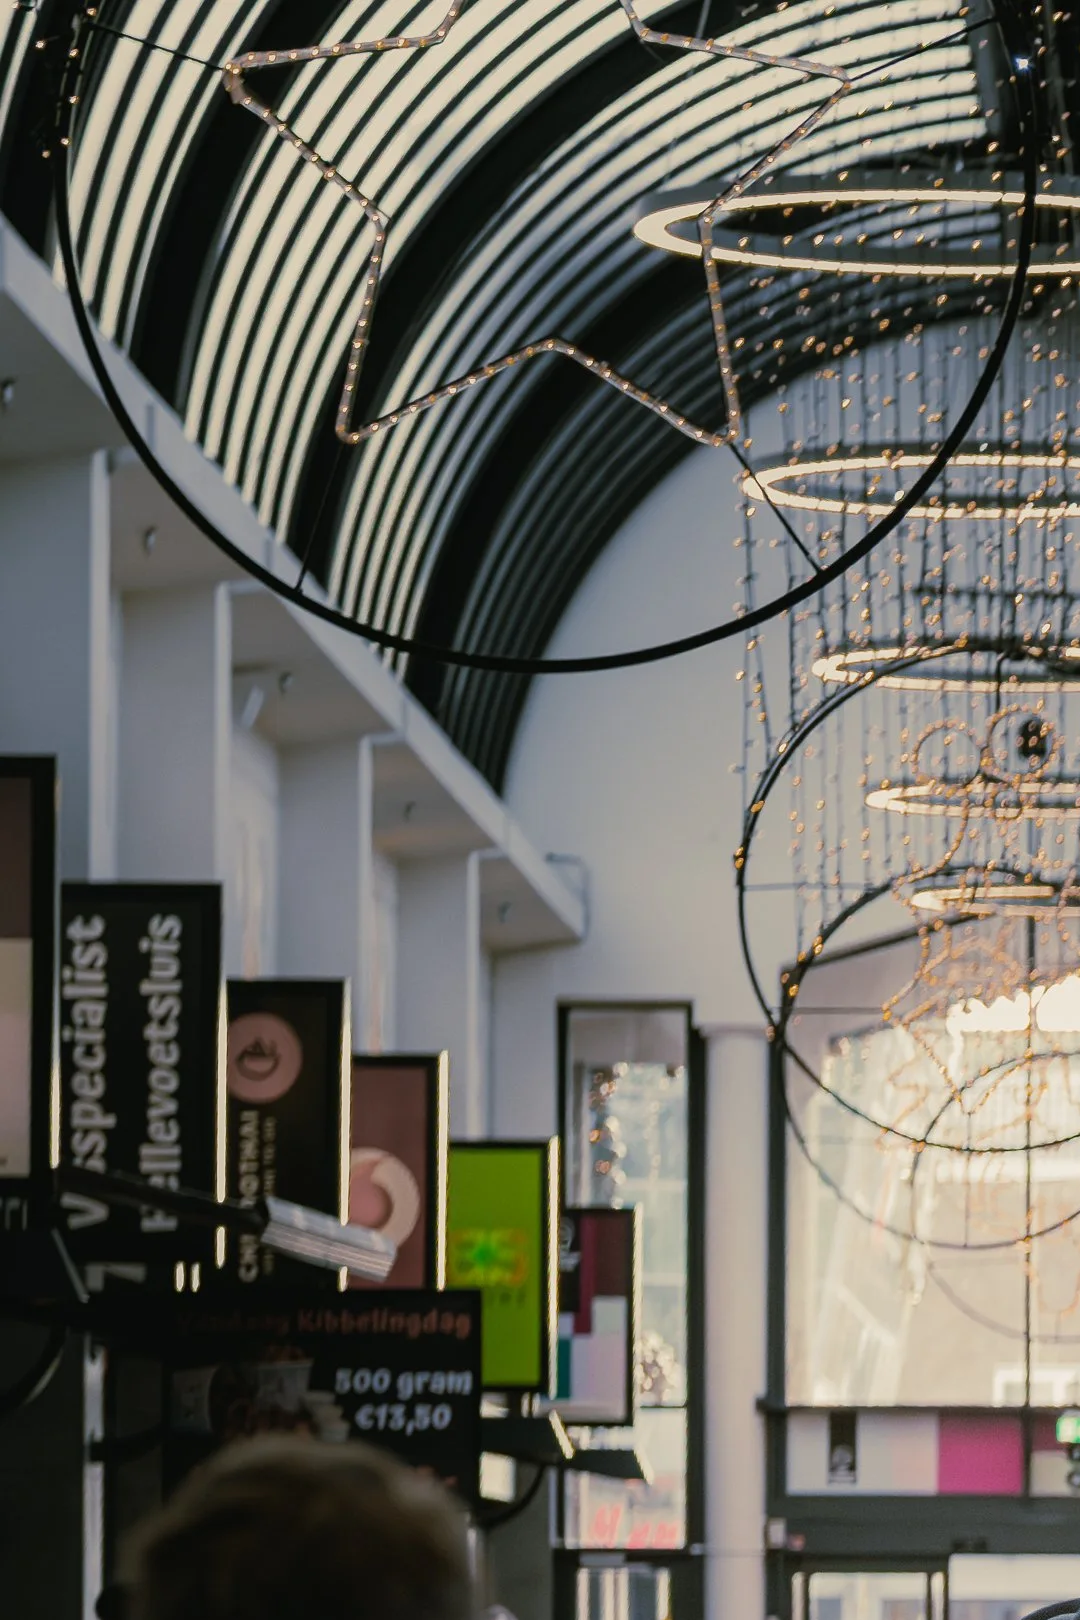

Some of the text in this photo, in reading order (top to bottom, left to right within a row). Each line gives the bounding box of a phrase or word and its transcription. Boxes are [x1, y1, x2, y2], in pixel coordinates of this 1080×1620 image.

[296, 1307, 473, 1341] Kibbelingdag
[334, 1366, 473, 1401] 500 gram
[353, 1402, 454, 1437] €13,50
